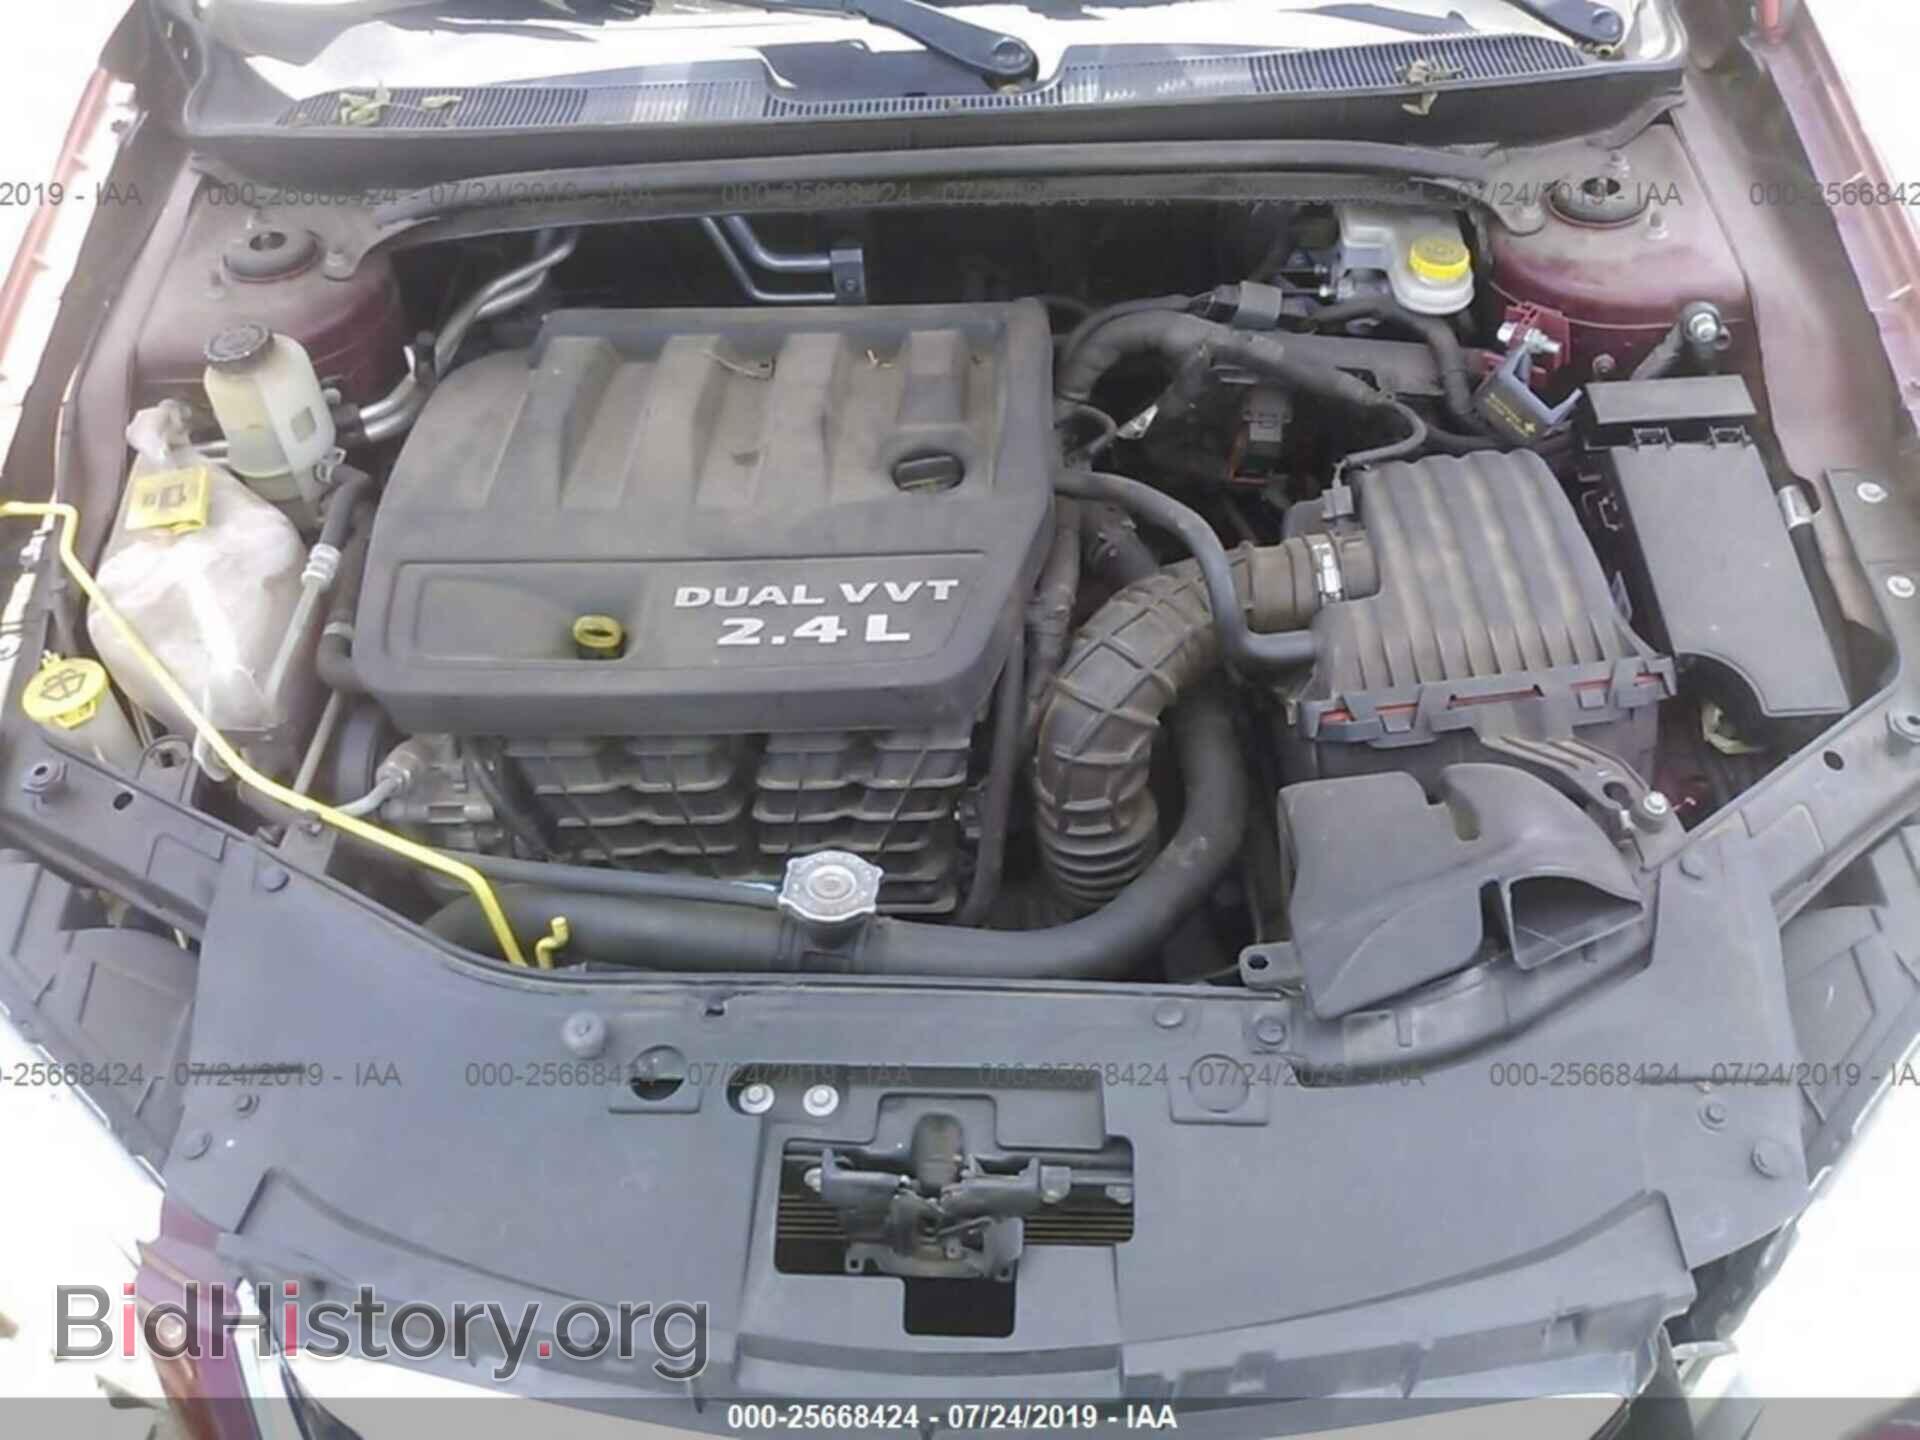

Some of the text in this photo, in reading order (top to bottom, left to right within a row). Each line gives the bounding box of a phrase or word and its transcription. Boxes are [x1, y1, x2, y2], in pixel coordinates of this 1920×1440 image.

[674, 579, 960, 608] DUAL VVT
[716, 613, 911, 646] 2.4 L
